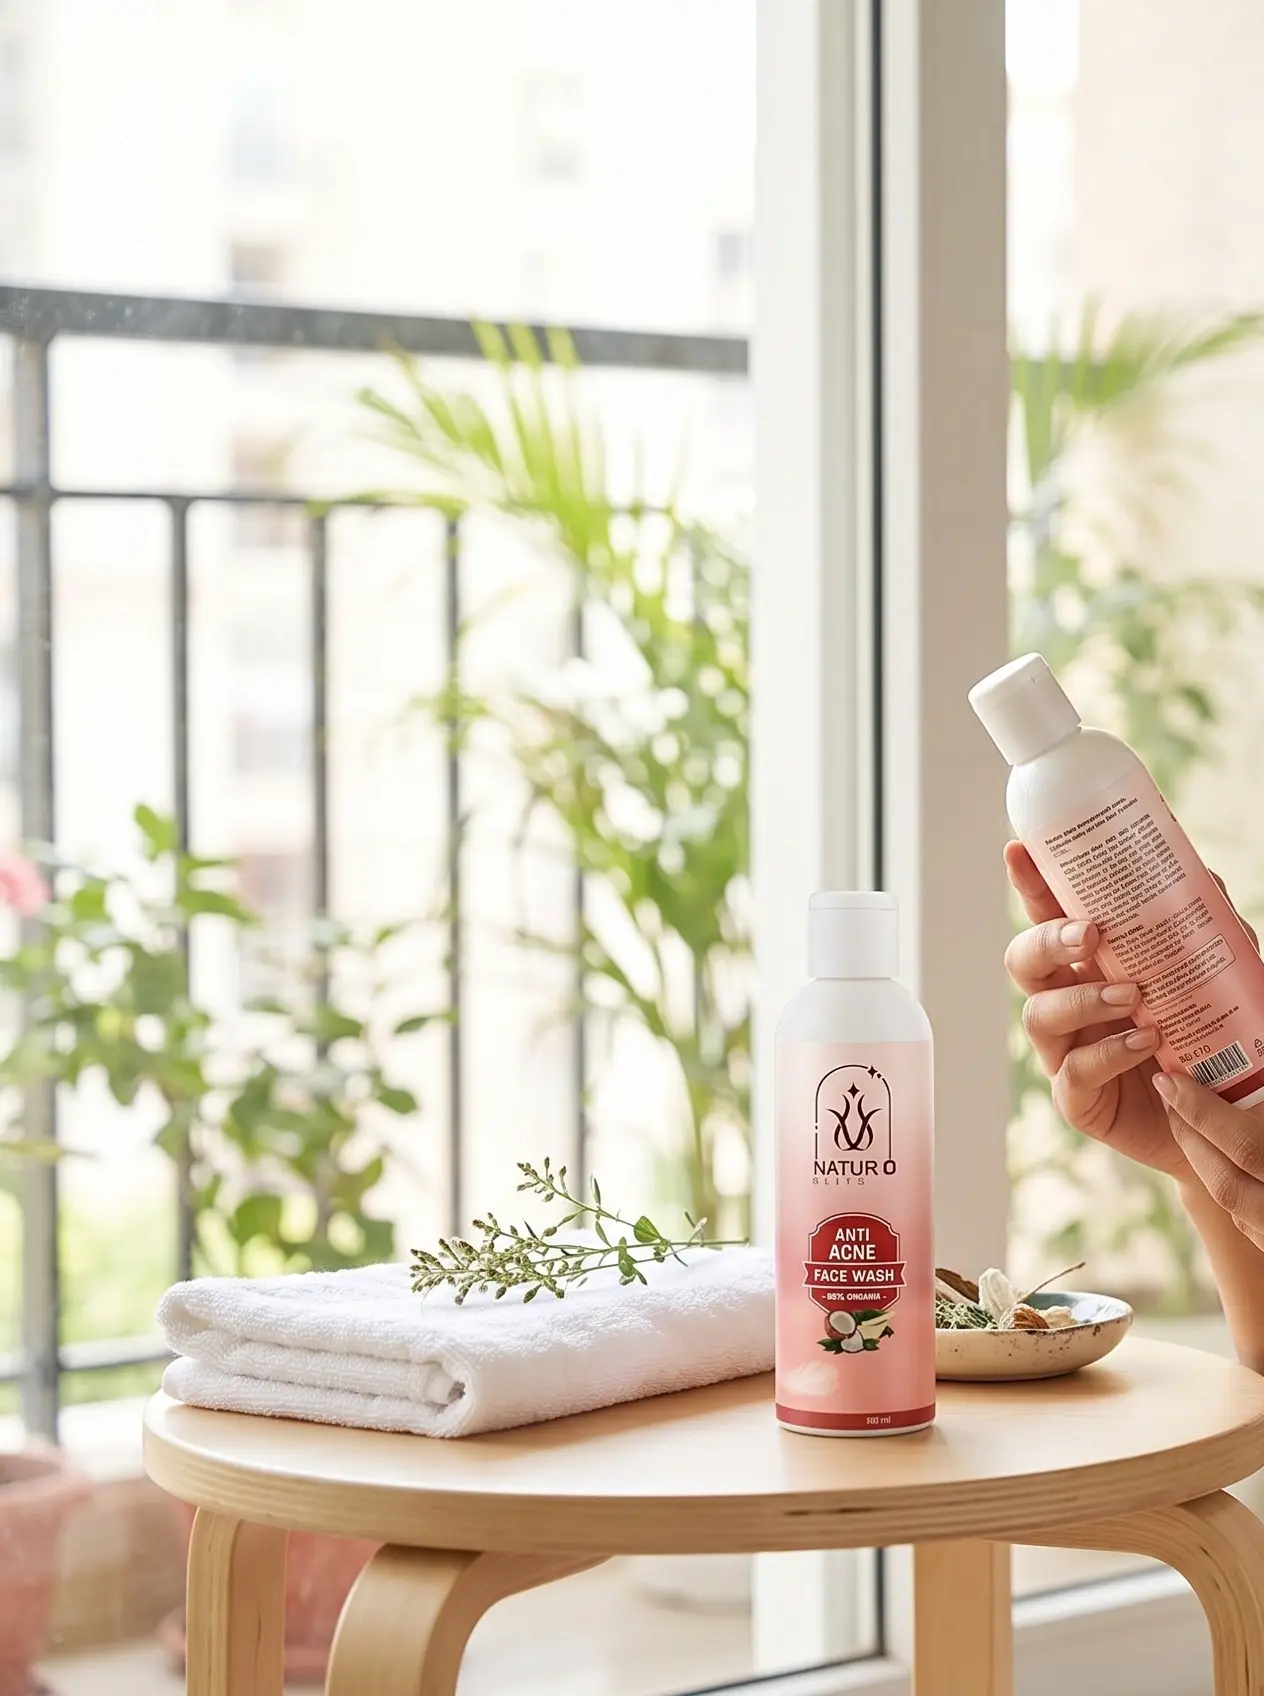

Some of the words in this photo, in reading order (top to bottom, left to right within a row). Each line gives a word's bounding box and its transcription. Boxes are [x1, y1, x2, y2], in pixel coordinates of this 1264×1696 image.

[834, 1227, 870, 1242] ANTI
[828, 1244, 876, 1260] ACNE
[814, 1268, 848, 1282] FACE
[852, 1268, 895, 1282] WASH
